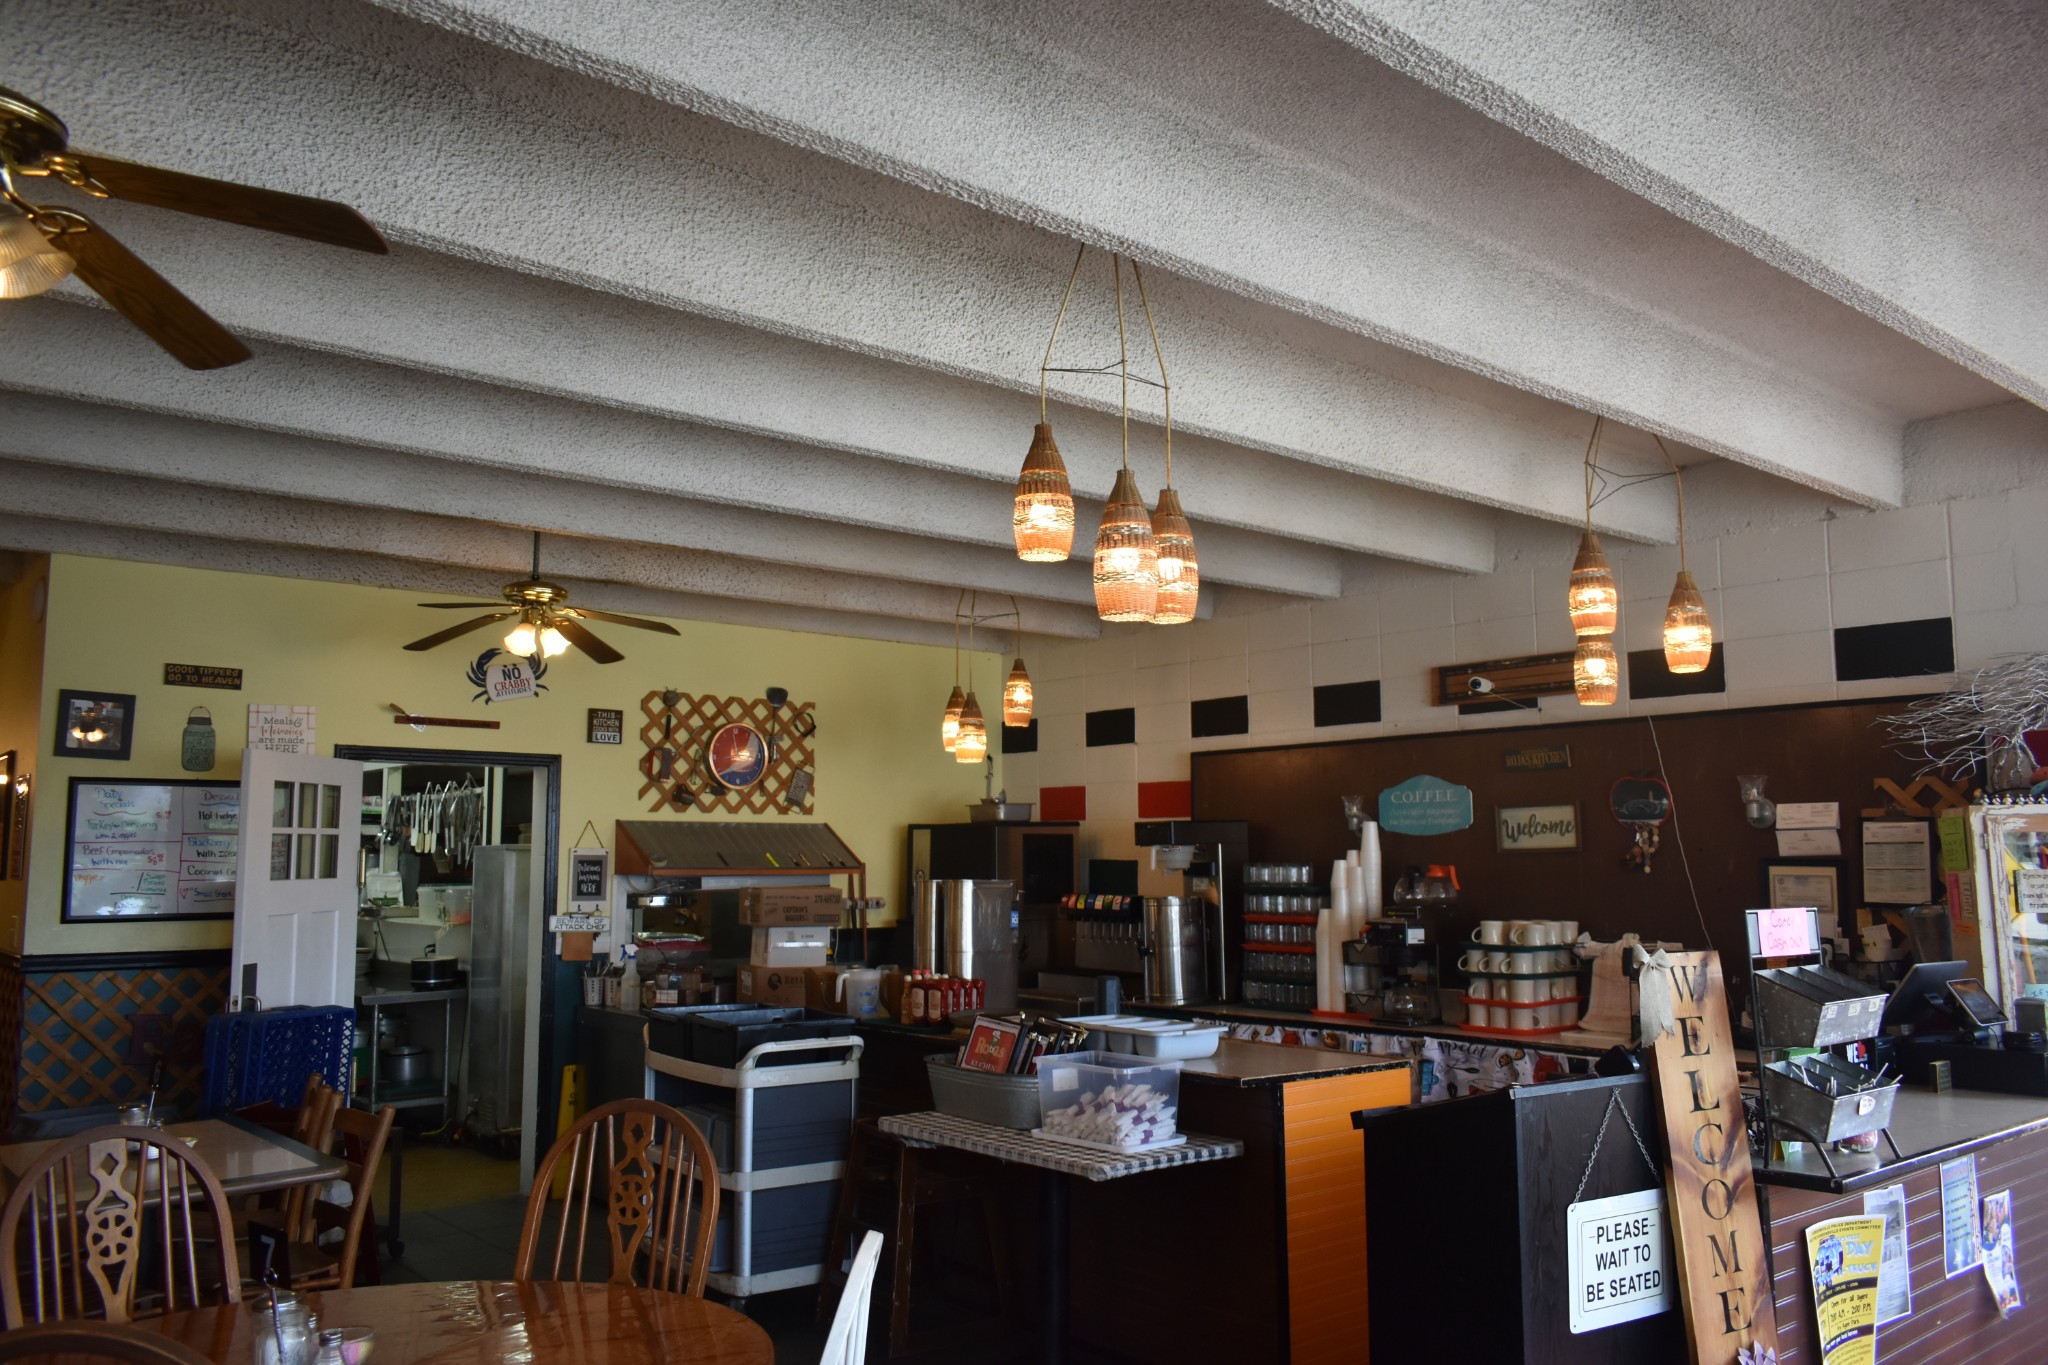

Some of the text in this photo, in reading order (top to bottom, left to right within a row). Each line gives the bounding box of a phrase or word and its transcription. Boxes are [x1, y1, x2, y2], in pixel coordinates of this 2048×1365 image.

[167, 664, 240, 677] GOOD TIPPERS
[502, 667, 521, 681] NO
[167, 673, 241, 685] GO TO HEAVEN
[494, 678, 531, 692] CRABBY
[496, 687, 532, 698] ATTITUDES
[263, 716, 293, 725] Meals
[597, 711, 616, 719] THIS
[593, 718, 620, 727] KITCHEN
[260, 726, 303, 737] Memories
[278, 736, 305, 744] made
[595, 733, 618, 742] LOVE
[265, 744, 299, 754] HERE
[1532, 751, 1567, 766] KITCHEN
[199, 810, 213, 820] Hot
[1502, 813, 1575, 842] Welcome
[83, 845, 104, 856] Beef
[581, 883, 597, 893] HERE
[556, 917, 590, 925] BEWARE
[1767, 932, 1788, 950] Cash
[1596, 1217, 1649, 1244] PLEASE
[260, 1234, 276, 1270] 7
[1846, 1241, 1875, 1257] DAY
[1595, 1244, 1651, 1272] WAIT TO
[1586, 1270, 1661, 1303] BE SEATED
